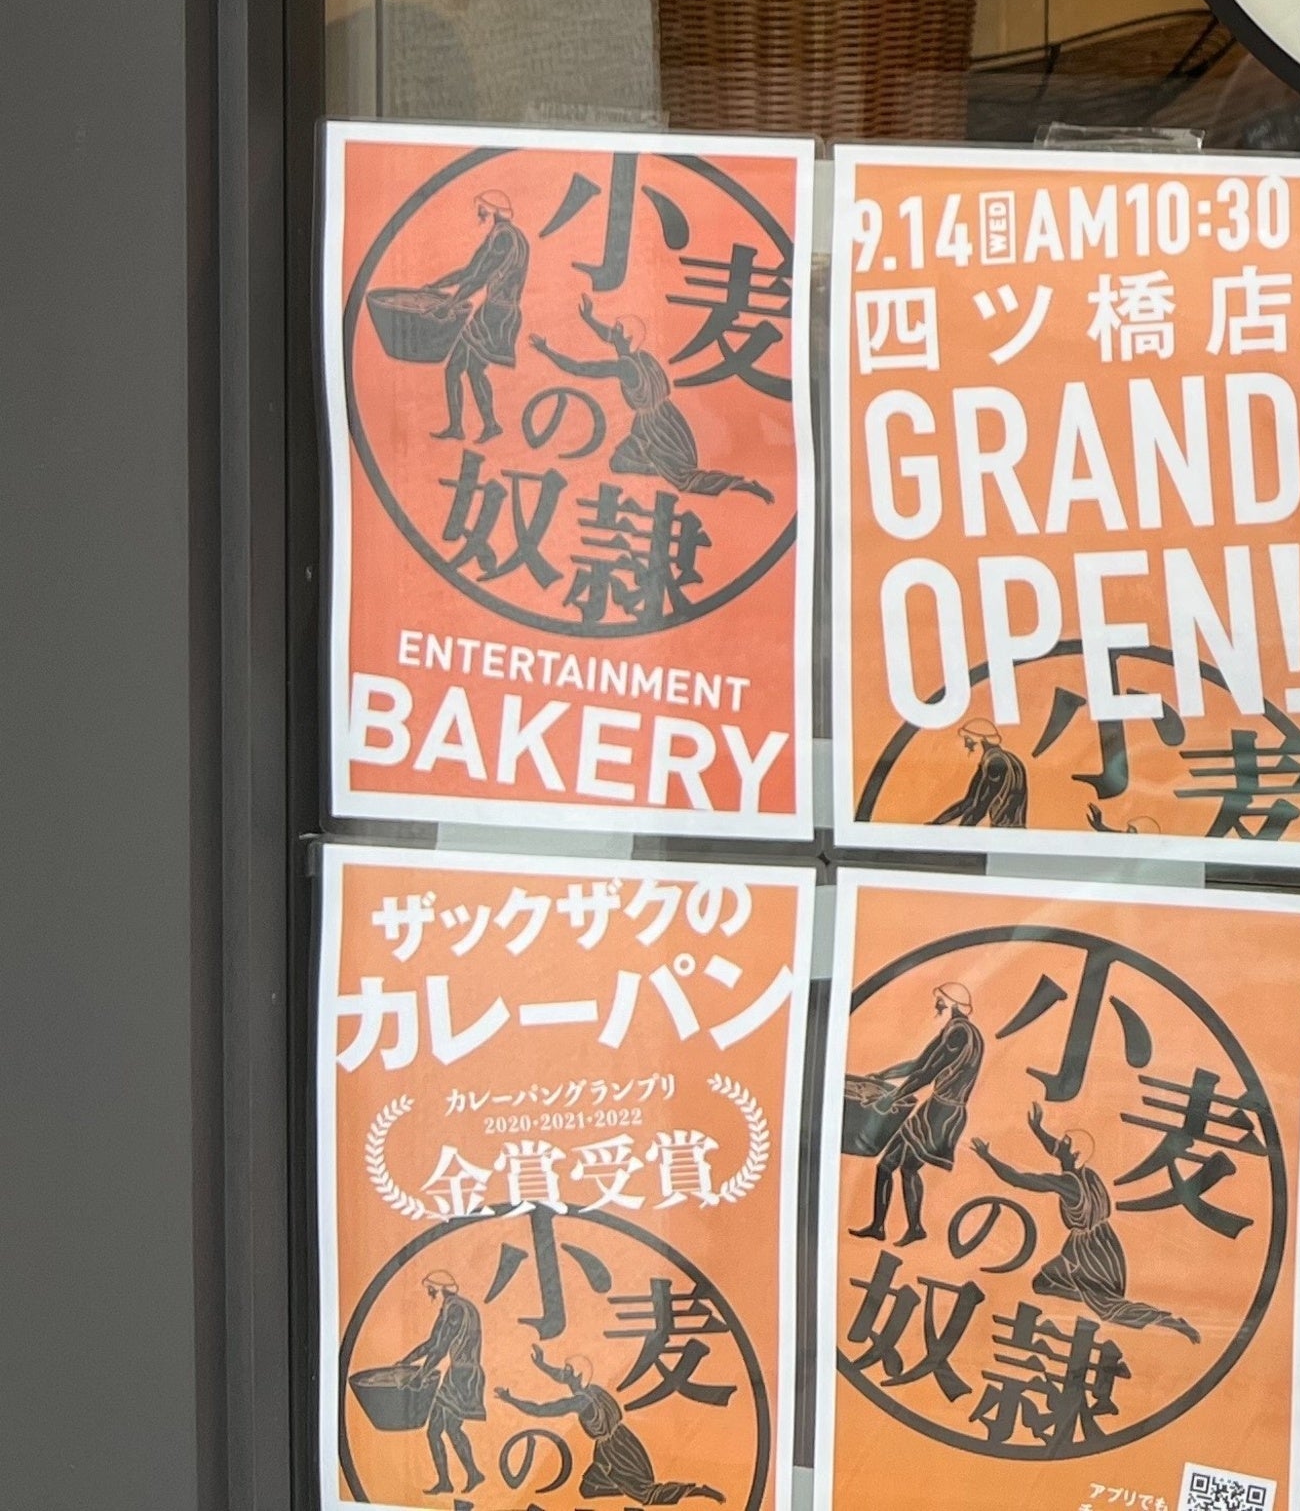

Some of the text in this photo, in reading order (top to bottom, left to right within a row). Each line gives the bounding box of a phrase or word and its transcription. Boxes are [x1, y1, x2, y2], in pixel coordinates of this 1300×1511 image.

[853, 193, 973, 272] 9.14
[855, 265, 1293, 375] 四ツ橋店
[398, 628, 750, 713] ENTERTAINMENT
[347, 673, 790, 812] BAKERY
[370, 877, 751, 963] ザックザクの
[335, 955, 792, 1075] カレーパン
[444, 1072, 677, 1117] カレーパングランプリ
[420, 1129, 720, 1218] 金賞受賞
